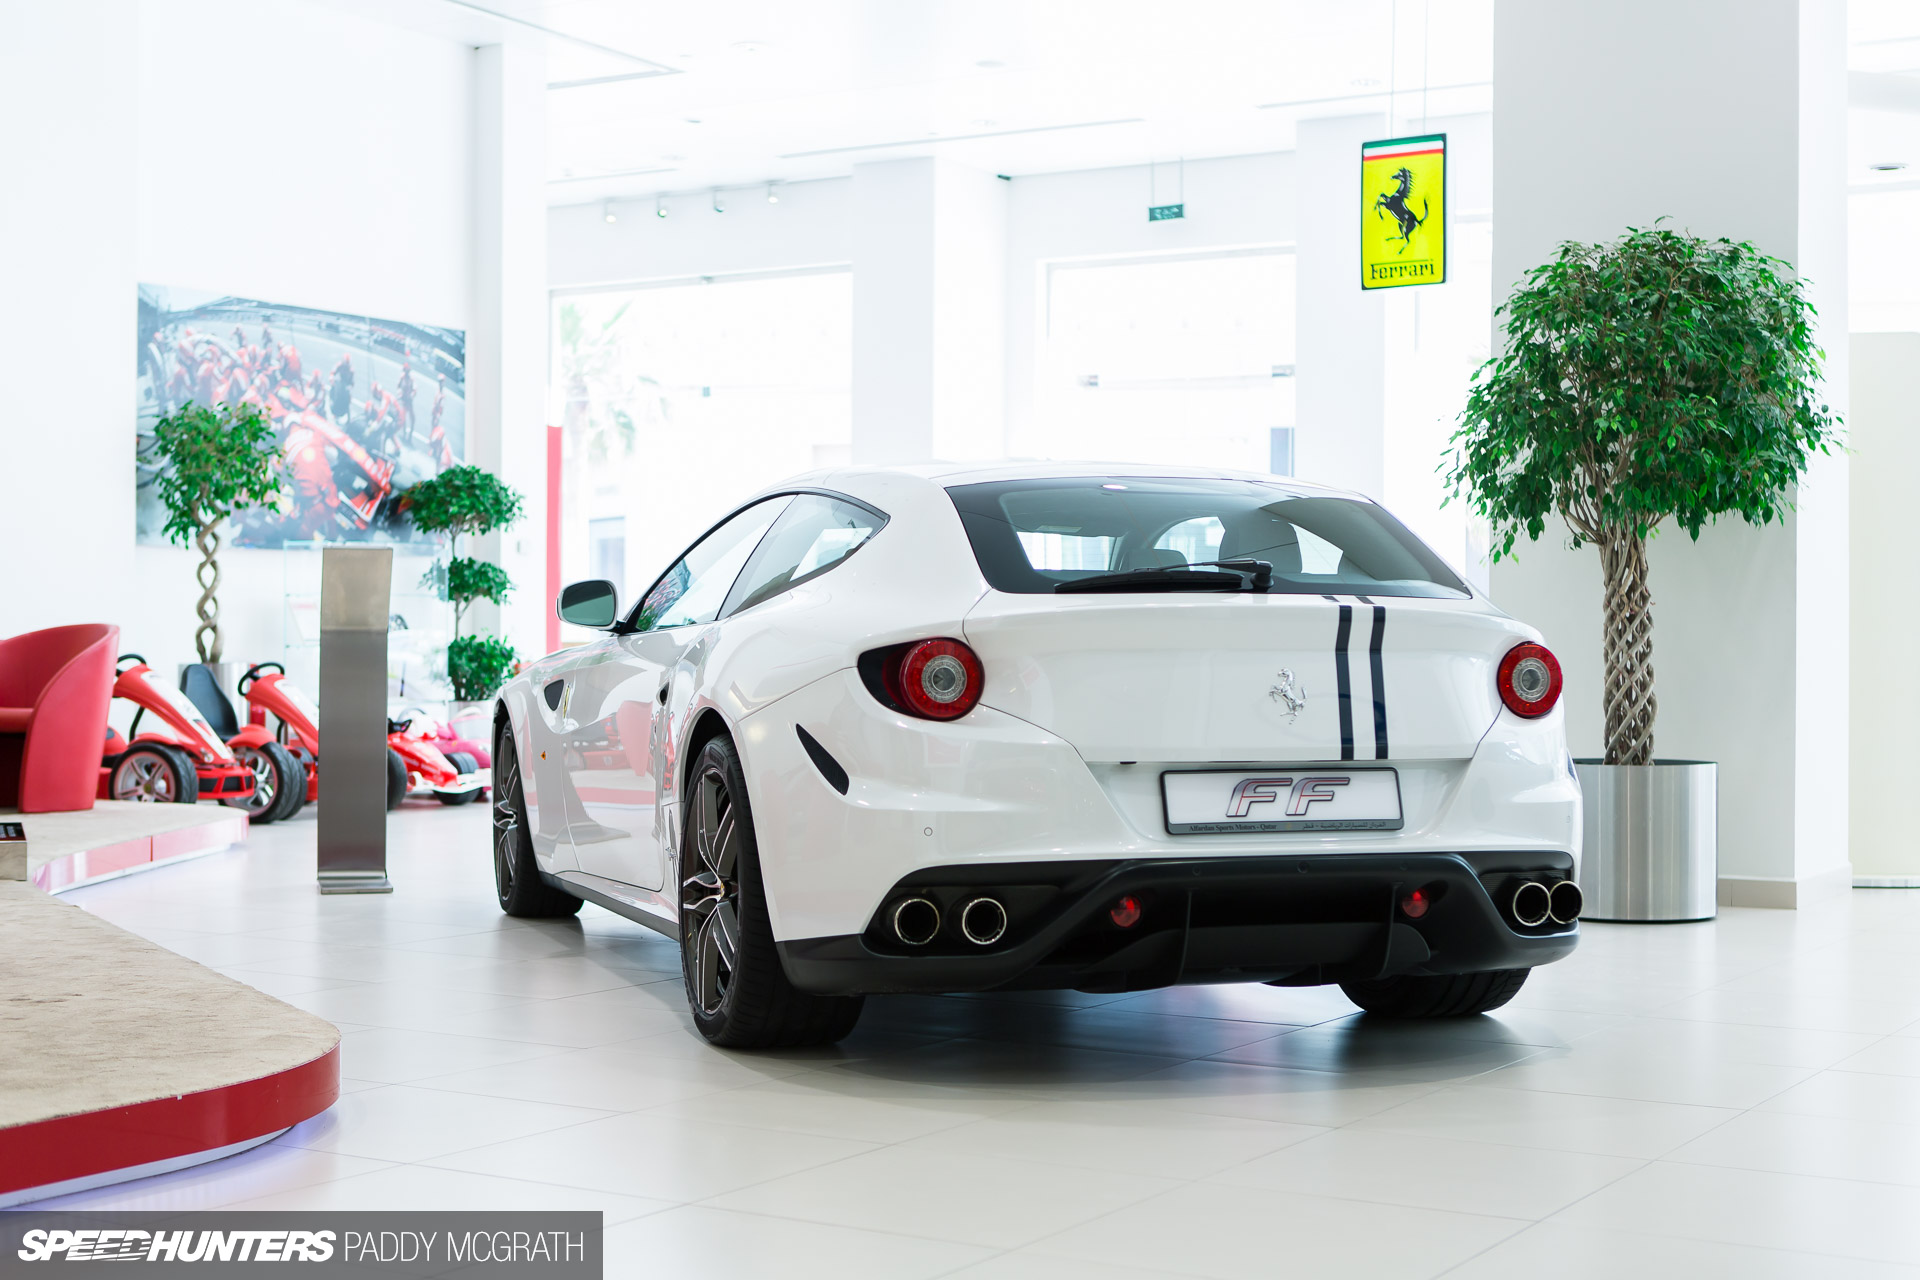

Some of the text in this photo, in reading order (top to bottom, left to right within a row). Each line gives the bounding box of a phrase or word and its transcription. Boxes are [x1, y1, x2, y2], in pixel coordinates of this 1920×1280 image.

[1370, 259, 1434, 280] Ferrari
[1226, 777, 1350, 817] FF
[1260, 823, 1277, 831] Qatar
